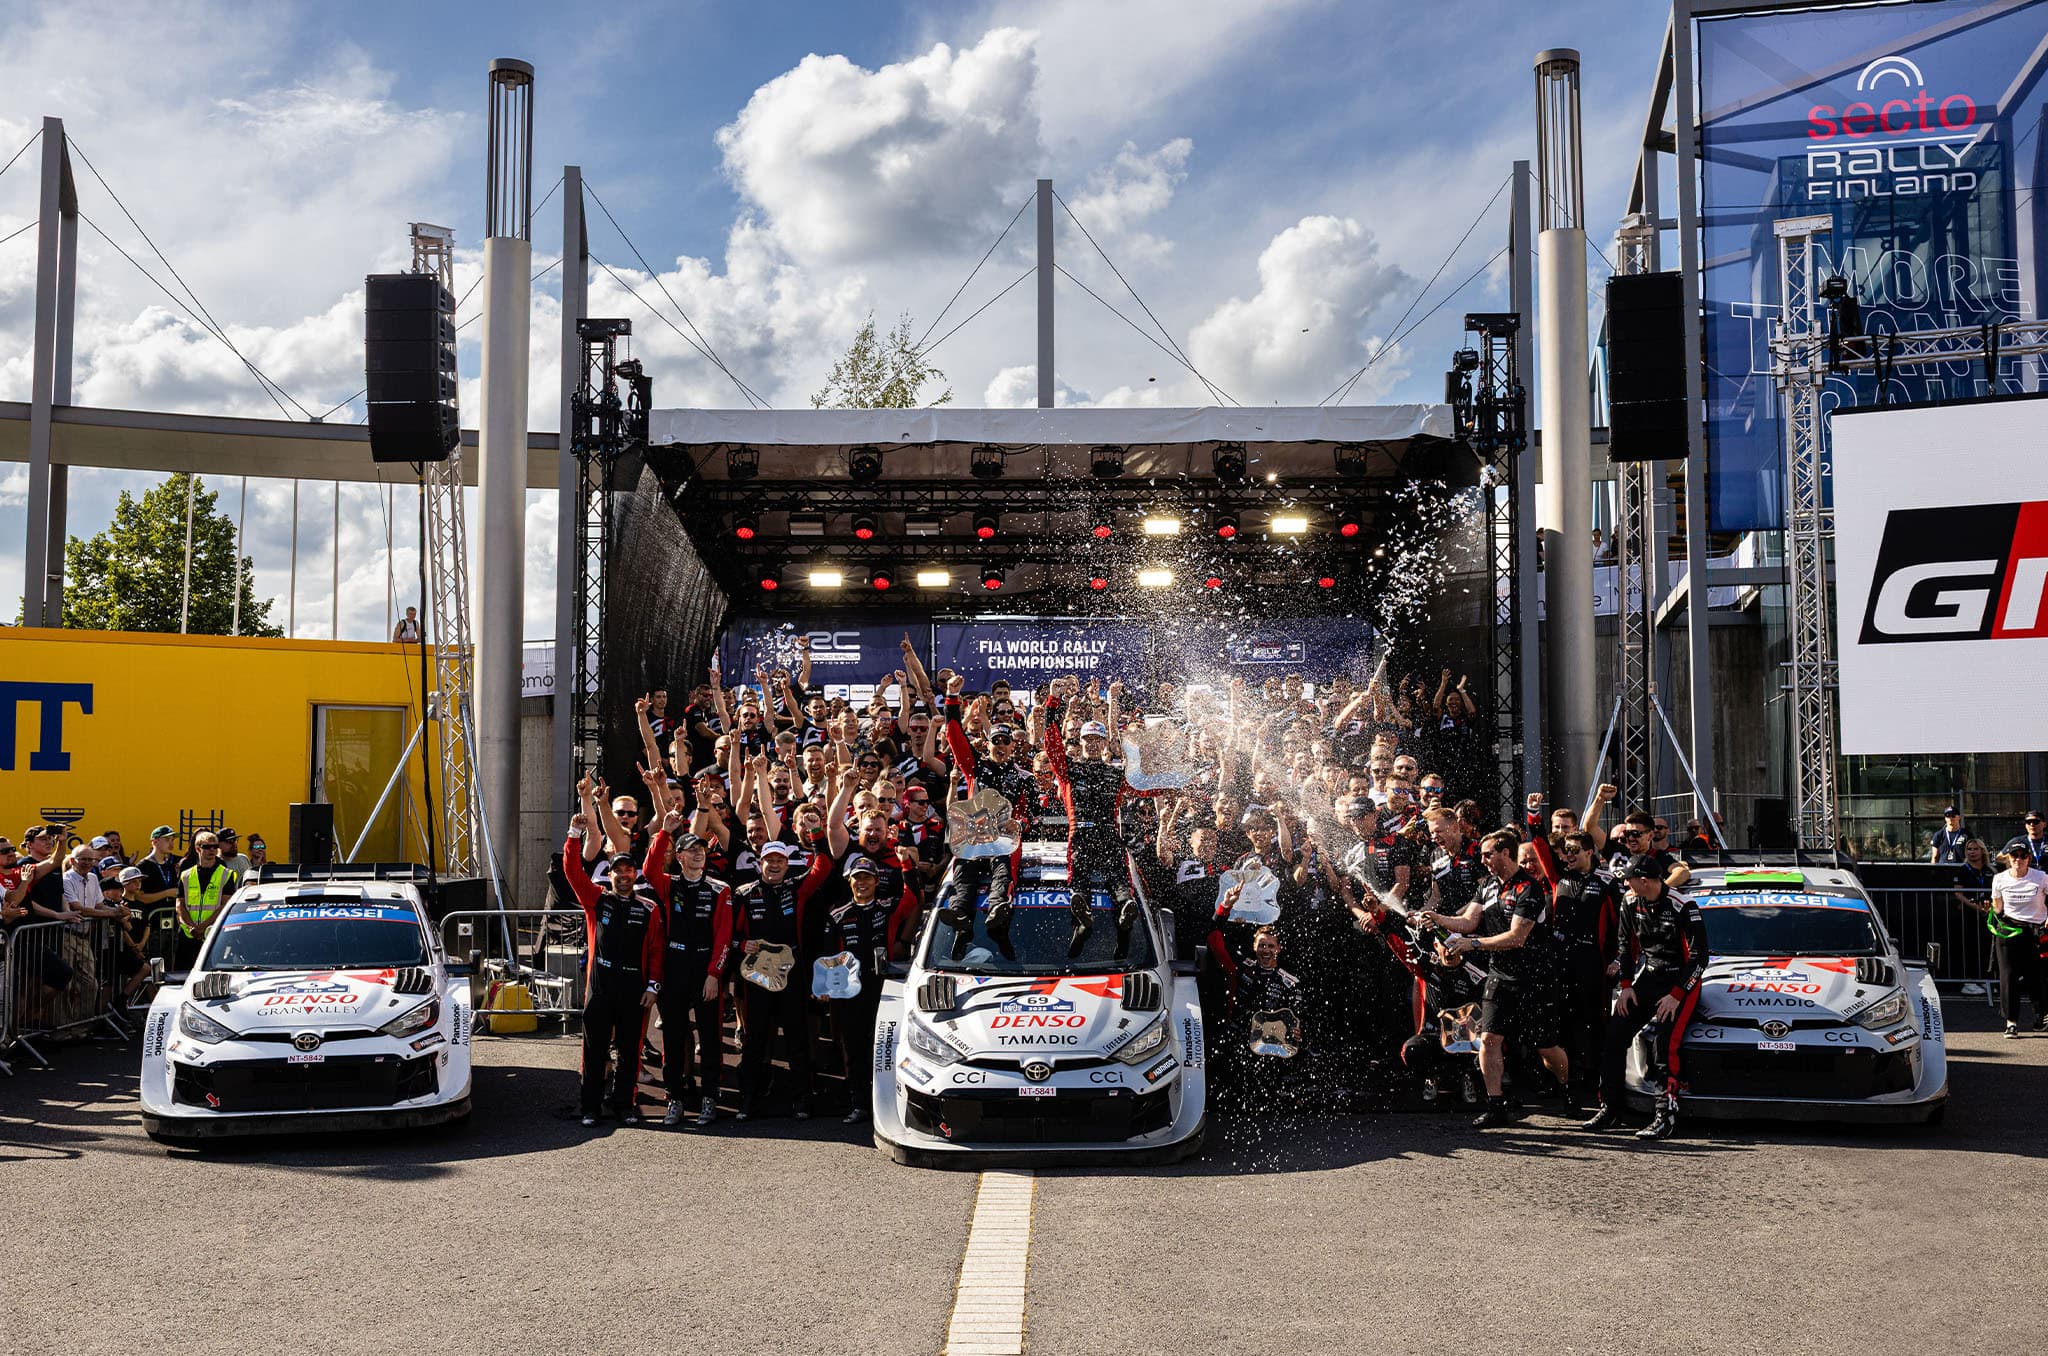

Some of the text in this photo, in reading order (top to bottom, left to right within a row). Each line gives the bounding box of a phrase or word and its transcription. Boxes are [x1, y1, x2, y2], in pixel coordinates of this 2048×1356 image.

[1808, 89, 1977, 141] secto
[1807, 141, 1977, 177] RALLY
[1808, 172, 1977, 200] FINLAND
[980, 640, 1107, 653] FIA WORLD RALLY
[988, 656, 1099, 669] CHAMPIONSHIP
[1726, 982, 1822, 994] DENSO
[264, 994, 359, 1006] DENSO
[1735, 998, 1815, 1008] TAMADIC
[451, 1003, 460, 1045] Panasonic
[990, 1015, 1087, 1028] DENSO
[1920, 996, 1931, 1040] Panasonic
[154, 1012, 169, 1056] Panasonic
[998, 1035, 1078, 1045] TAMADIC
[1824, 1031, 1860, 1043] CCi
[876, 1021, 884, 1073] AUTOMOTIVE
[885, 1021, 896, 1071] Panasonic
[1182, 1018, 1193, 1067] Panasonic
[1759, 1042, 1794, 1050] NT-5839
[952, 1071, 986, 1084] CCi
[1090, 1071, 1123, 1083] CCi
